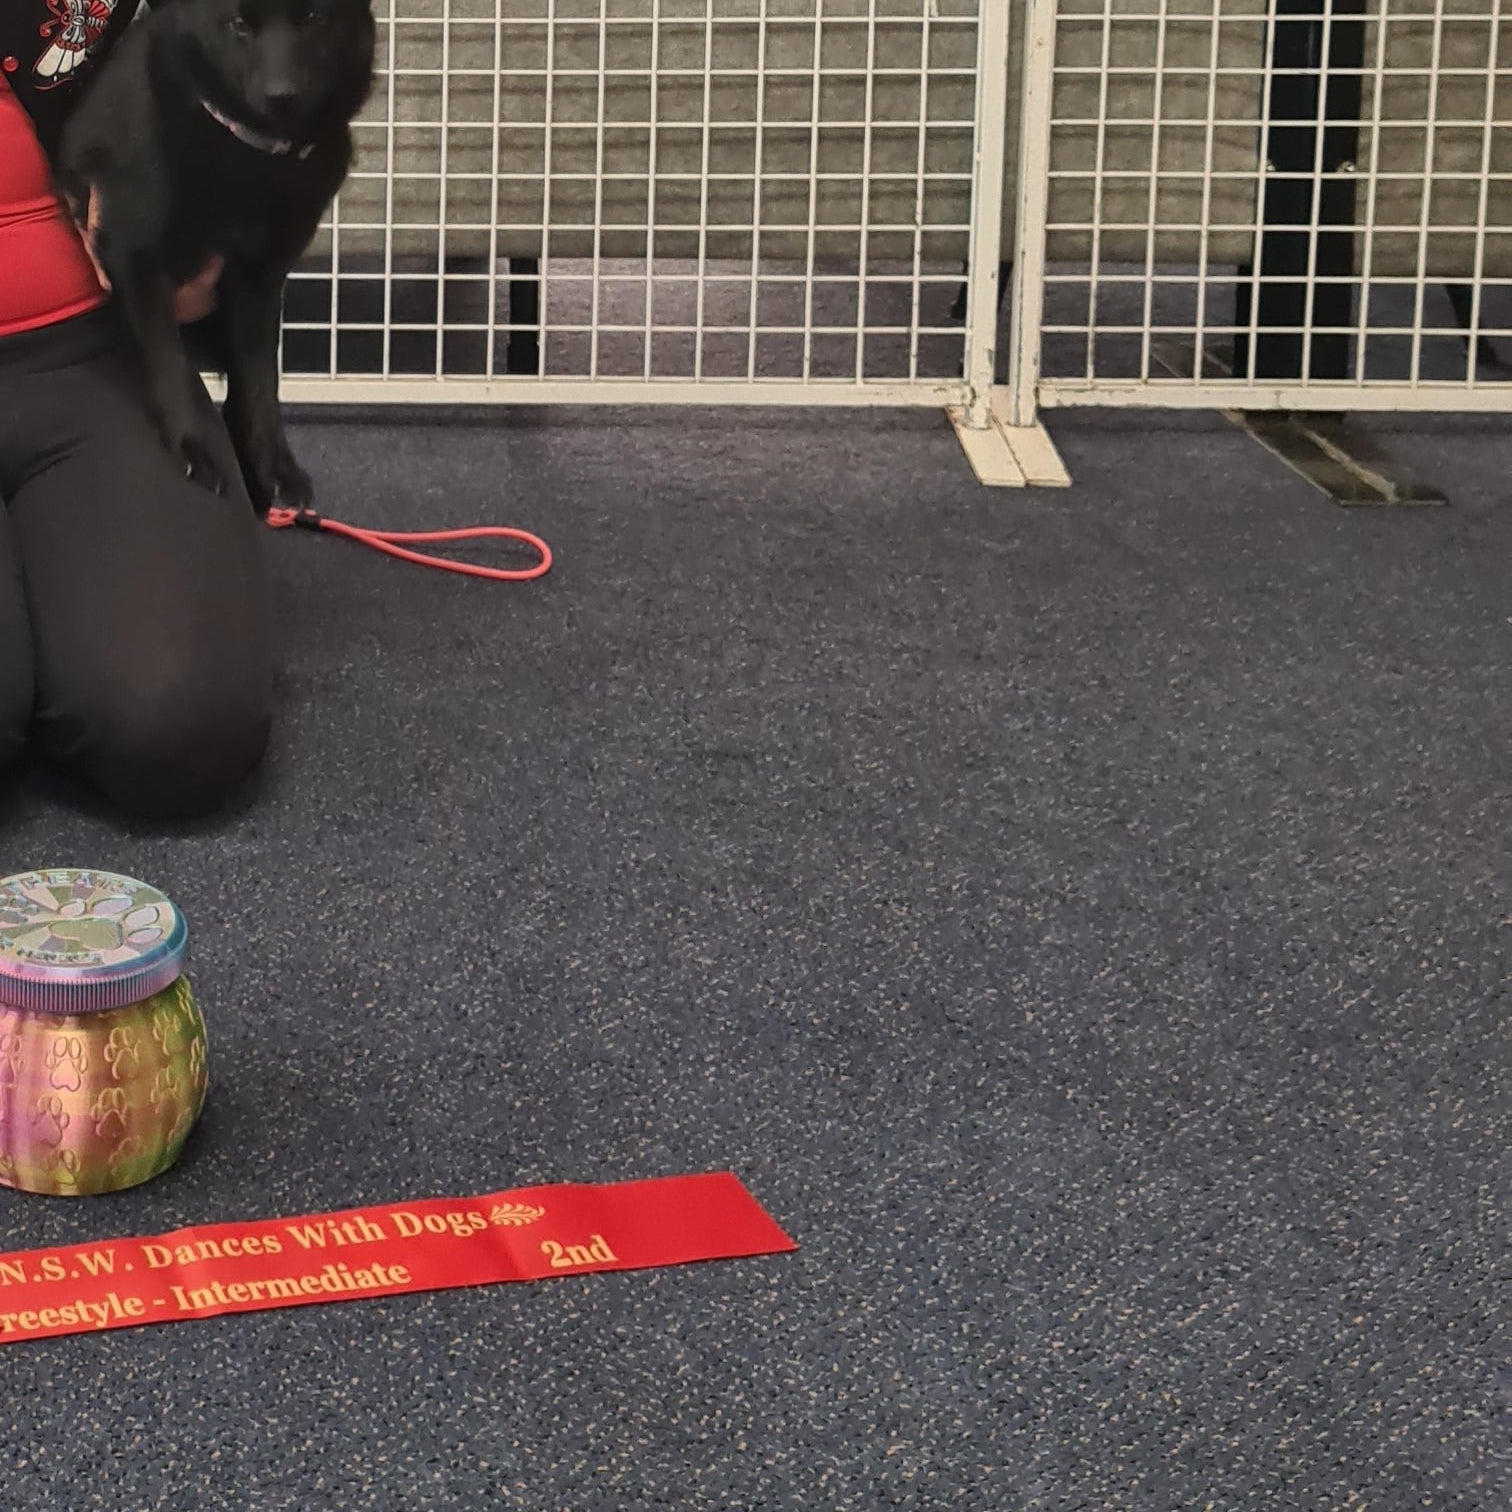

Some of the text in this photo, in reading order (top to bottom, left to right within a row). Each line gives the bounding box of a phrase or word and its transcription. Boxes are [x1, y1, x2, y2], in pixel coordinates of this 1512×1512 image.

[142, 1232, 282, 1270] Dances
[285, 1215, 389, 1251] With
[390, 1206, 489, 1238] Dogs
[541, 1234, 618, 1269] 2nd
[170, 1262, 412, 1312] Intermediate
